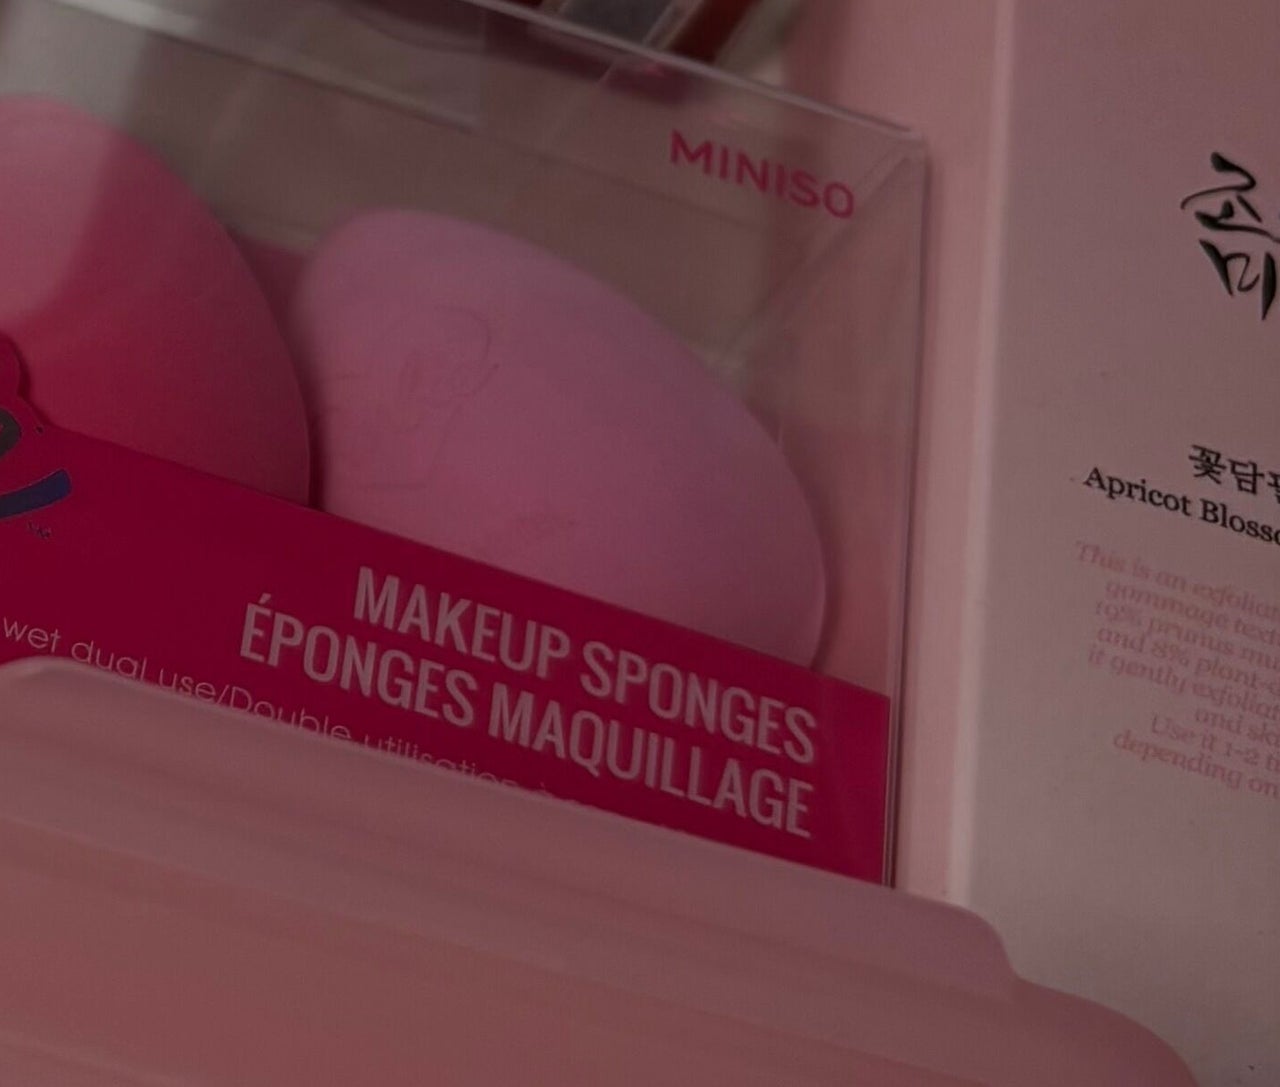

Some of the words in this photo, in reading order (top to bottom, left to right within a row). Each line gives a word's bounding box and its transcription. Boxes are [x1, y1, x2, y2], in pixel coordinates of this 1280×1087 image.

[670, 128, 855, 219] MINISO
[1083, 467, 1192, 517] Apricot
[1, 613, 62, 654] wet
[70, 637, 148, 682] dual
[353, 565, 570, 679] MAKEUP
[579, 640, 817, 765] SPONGES
[239, 592, 477, 727] ÉPONGES
[488, 682, 813, 839] MAQUILLAGE
